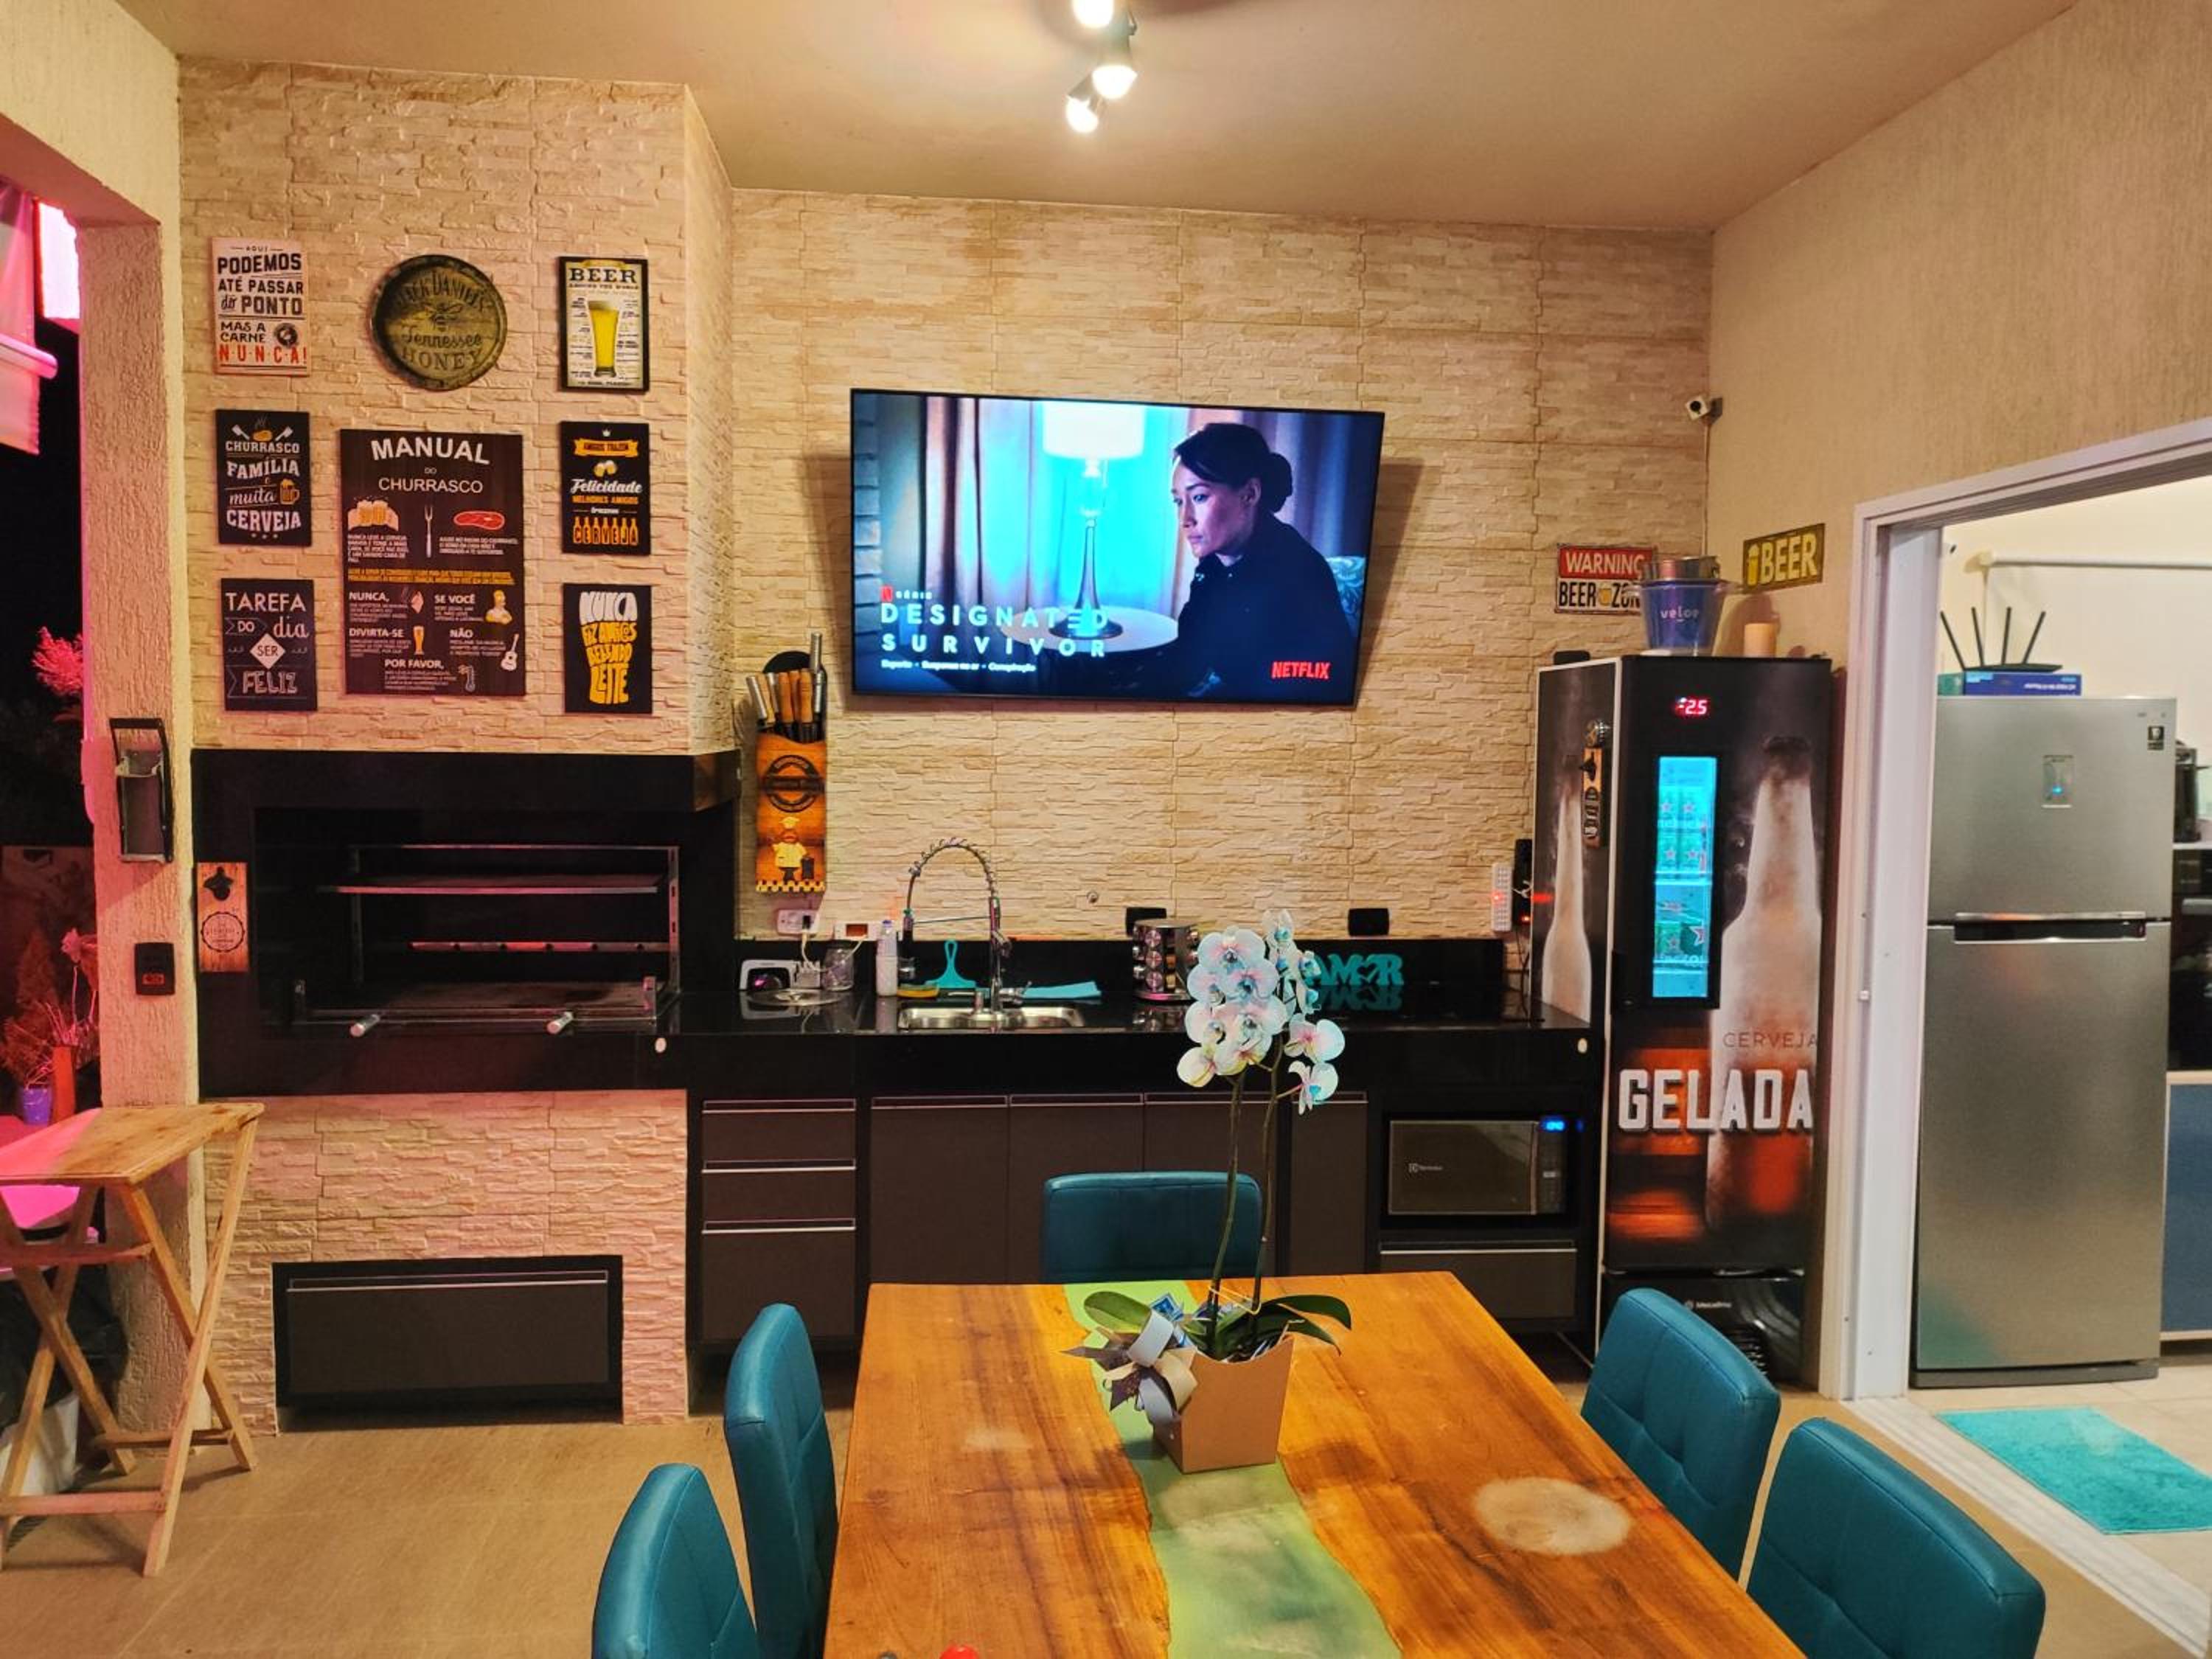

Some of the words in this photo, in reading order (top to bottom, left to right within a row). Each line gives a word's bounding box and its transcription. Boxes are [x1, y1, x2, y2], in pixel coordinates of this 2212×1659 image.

[218, 253, 302, 274] PODEMOS
[218, 276, 243, 292] ATÉ
[248, 279, 303, 294] PASSAR
[568, 268, 637, 283] BEER
[241, 296, 302, 316] PONTO
[220, 321, 251, 332] MAS
[256, 322, 266, 333] A
[220, 333, 266, 343] CARNE
[402, 348, 482, 370] HONEY
[225, 441, 300, 453] CHURRASCO
[371, 437, 490, 465] MANUAL
[226, 456, 300, 479] FAMÍLIA
[378, 478, 483, 493] CHURRASCO
[570, 479, 643, 494] Felicidade
[229, 487, 276, 504] muita
[226, 509, 302, 532] CERVEJA
[1565, 552, 1644, 574] WARNING
[1760, 532, 1818, 584] BEER
[225, 592, 306, 612] TAREFA
[434, 594, 446, 604] SE
[1559, 582, 1596, 607] BEER
[1611, 582, 1641, 608] ZON
[880, 602, 1108, 628] DESIGNATED
[237, 621, 255, 632] DO
[273, 616, 310, 638] dia
[349, 628, 405, 638] DIVIRTA-SE
[450, 627, 473, 638] NÃO
[258, 645, 278, 657] SER
[881, 633, 1105, 657] SURVIVOR
[384, 658, 406, 668] POR
[1271, 661, 1330, 680] NETFLIX
[1722, 1032, 1817, 1048] CERVEJA
[1618, 1069, 1813, 1130] GELADA
